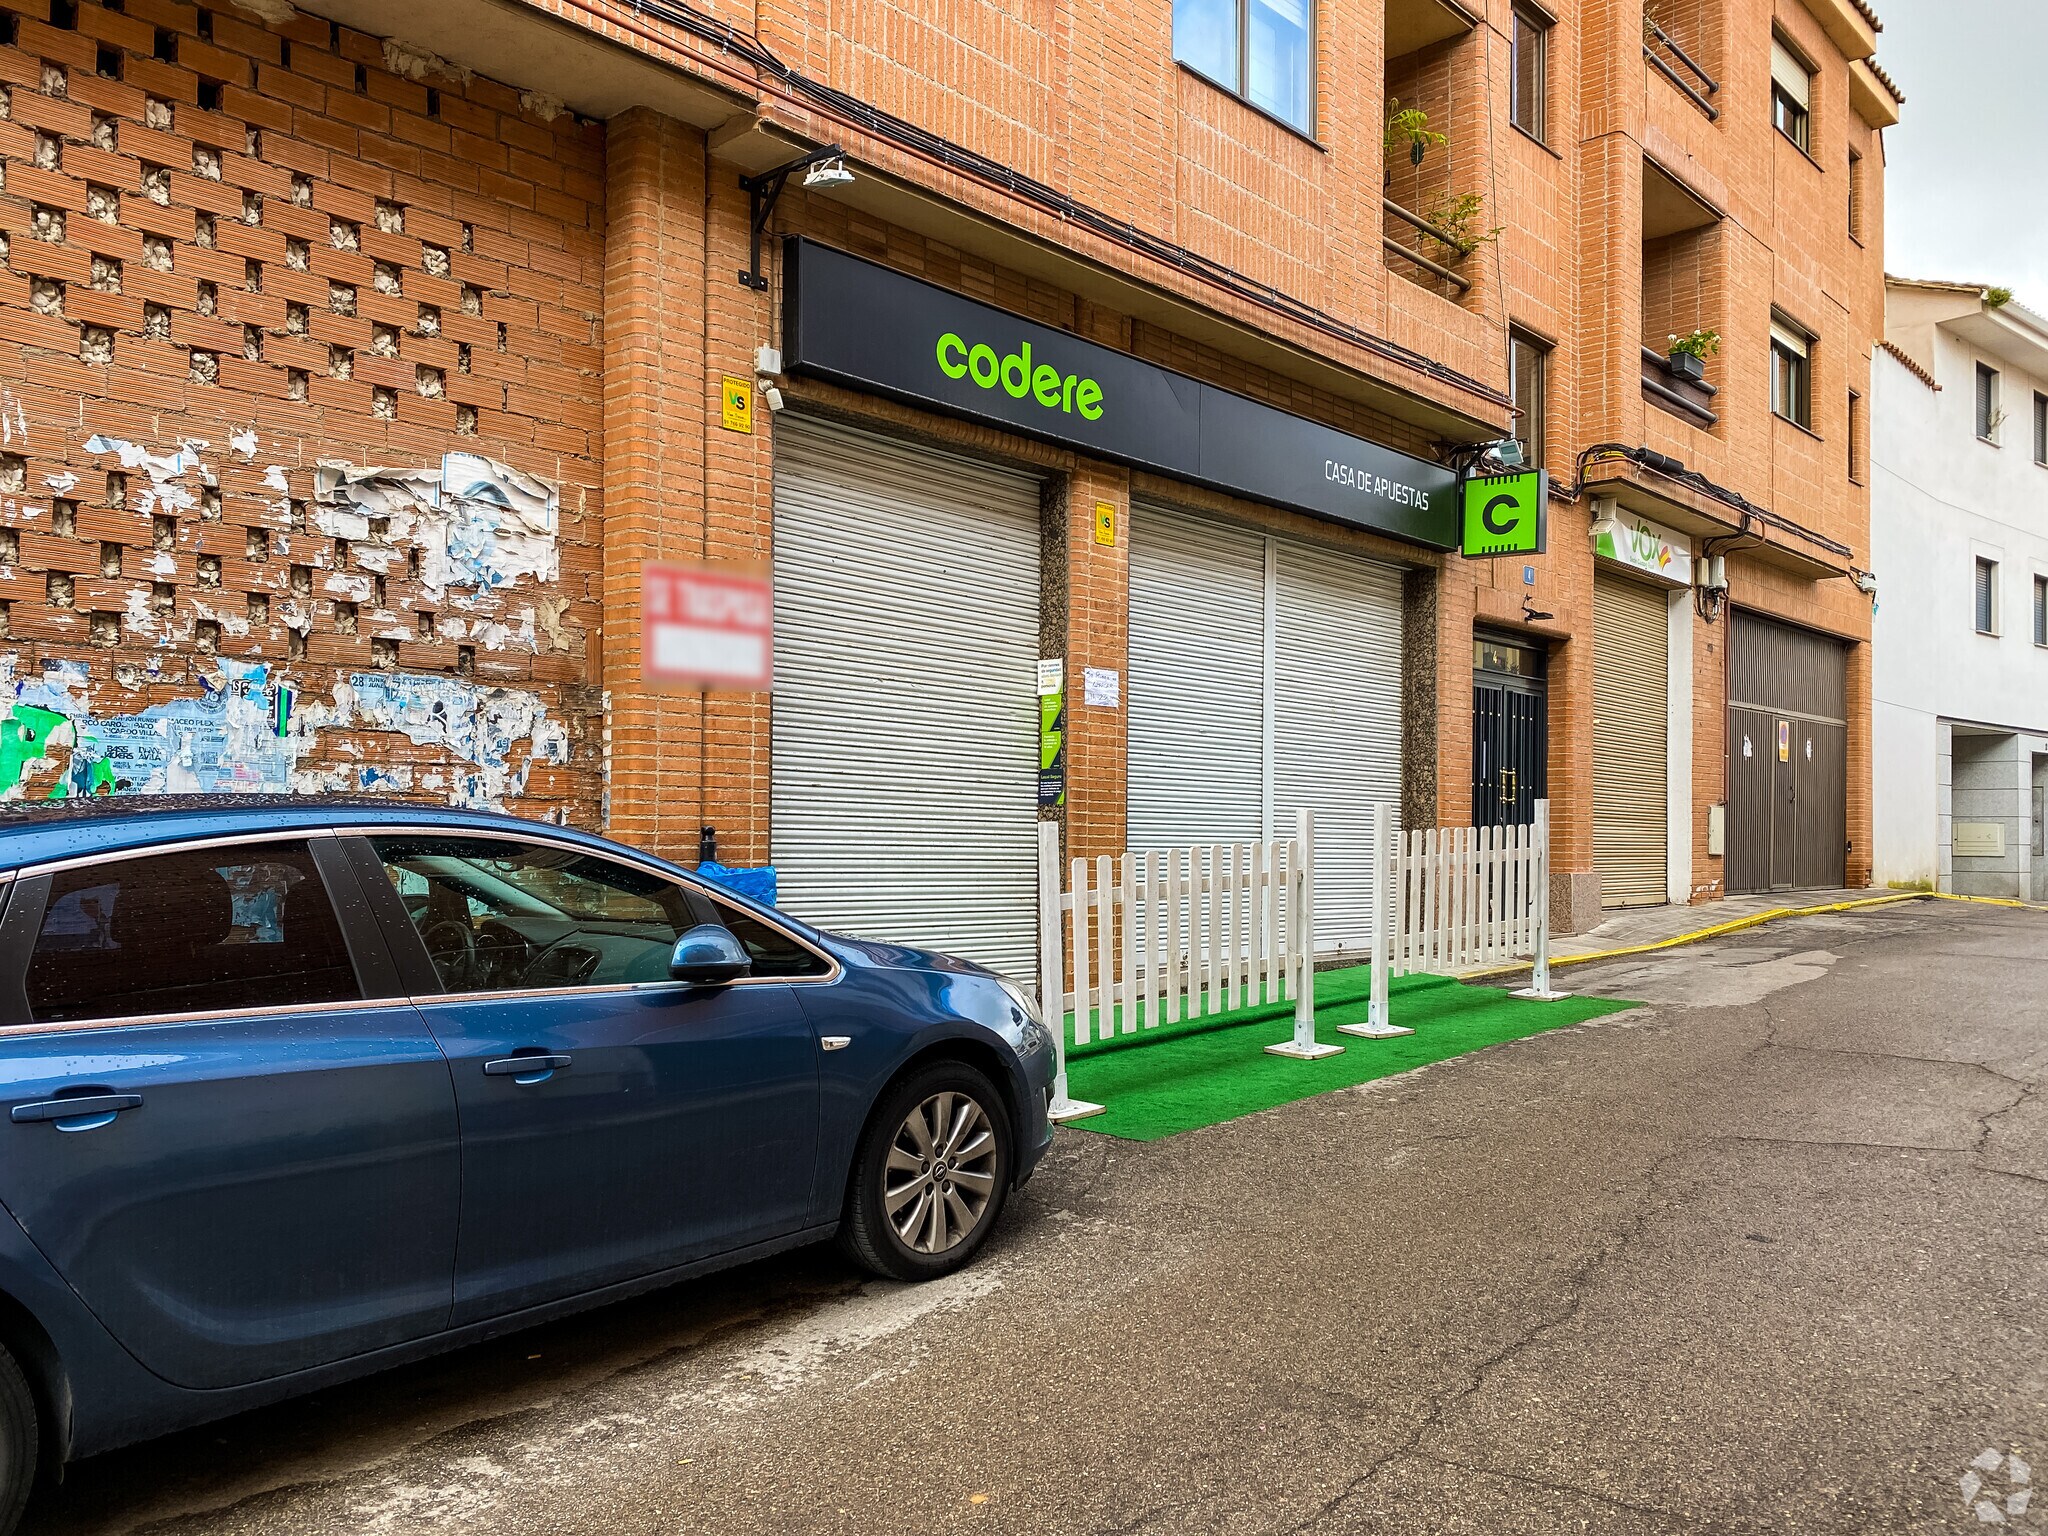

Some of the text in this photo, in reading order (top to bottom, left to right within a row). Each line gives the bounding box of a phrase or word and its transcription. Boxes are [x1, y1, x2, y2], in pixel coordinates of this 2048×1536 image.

[723, 378, 751, 389] PROTEGIDO
[936, 332, 1104, 421] codere
[729, 390, 746, 411] VS
[1325, 459, 1429, 511] CASA DE APUESTAS
[1482, 494, 1520, 535] C
[1631, 519, 1662, 562] VOX
[351, 675, 364, 687] 28
